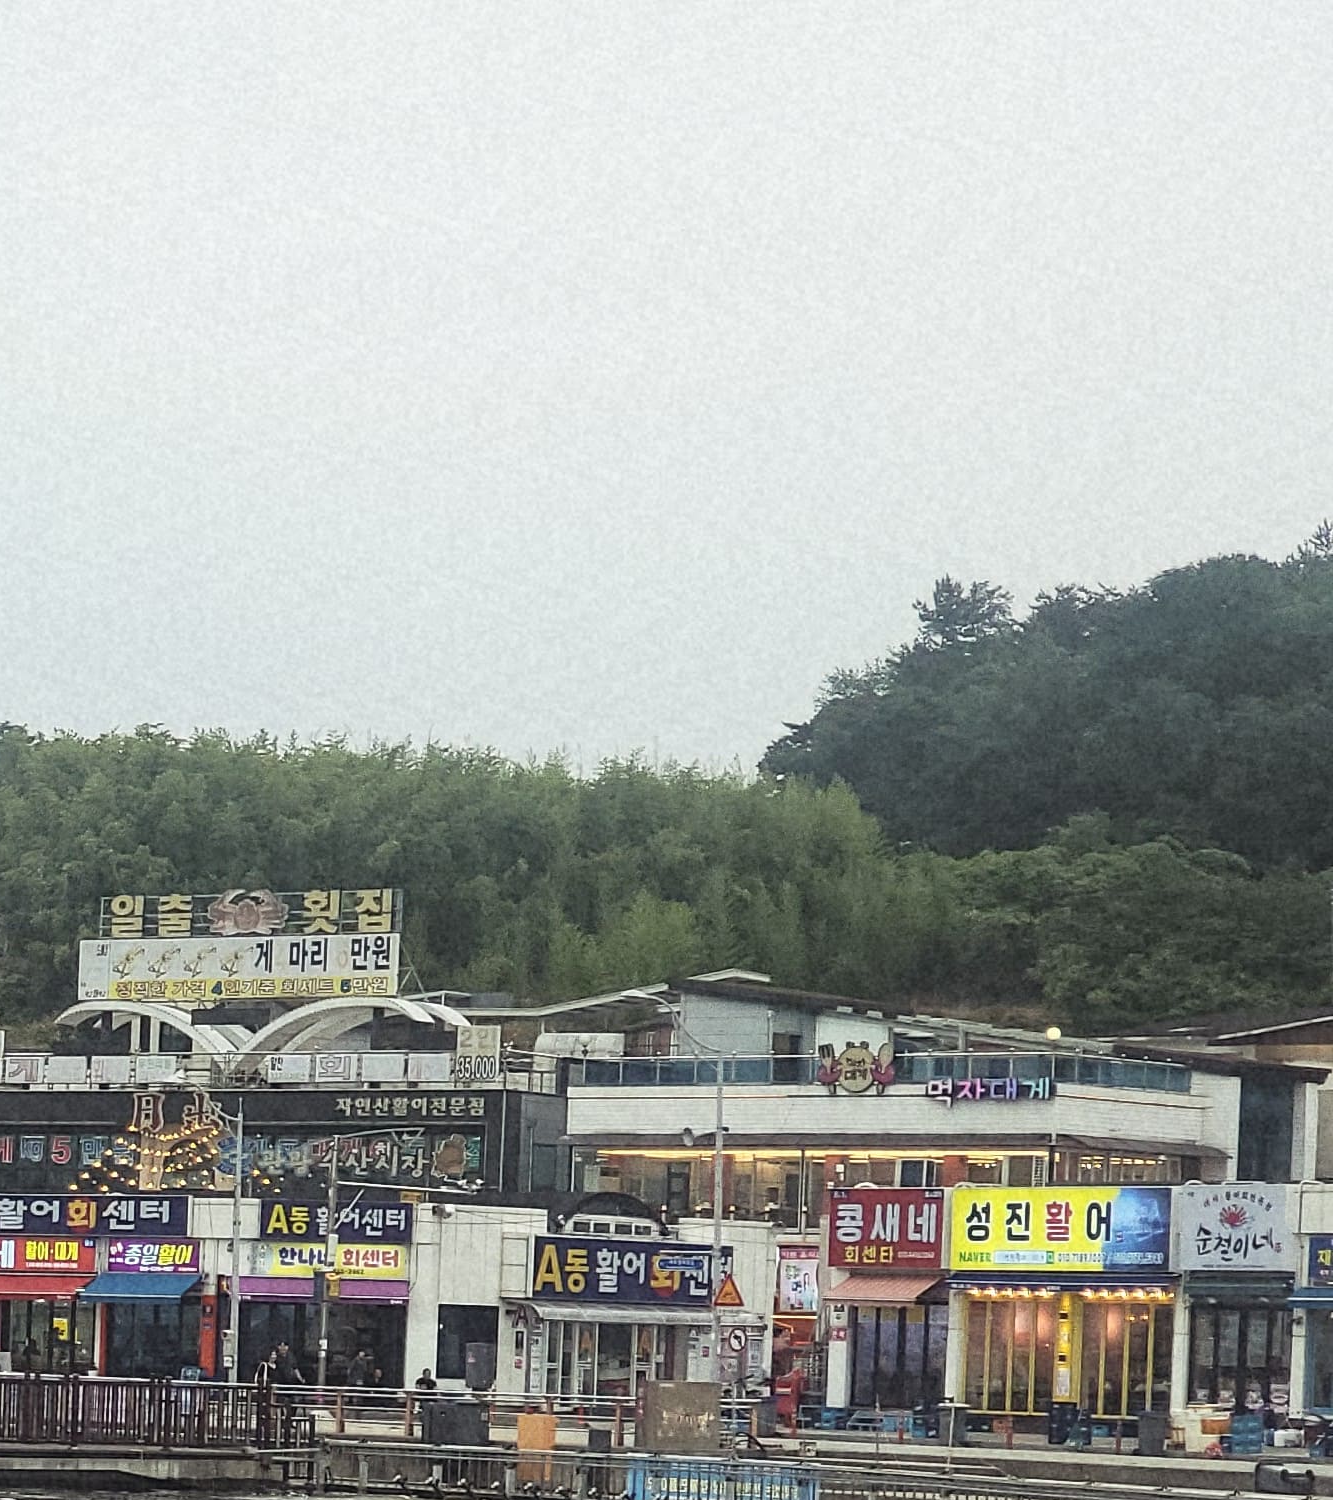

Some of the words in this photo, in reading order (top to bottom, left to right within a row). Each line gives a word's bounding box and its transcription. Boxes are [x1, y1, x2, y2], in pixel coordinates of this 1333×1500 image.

[110, 894, 192, 938] 일출
[302, 889, 393, 934] 횟집
[254, 940, 274, 973] 게
[289, 938, 329, 972] 마리
[928, 1077, 1051, 1107] 먹자대게
[266, 1204, 310, 1235] A동
[836, 1203, 937, 1243] 콩새네
[342, 1248, 400, 1268] 회센터
[534, 1243, 590, 1294] A동
